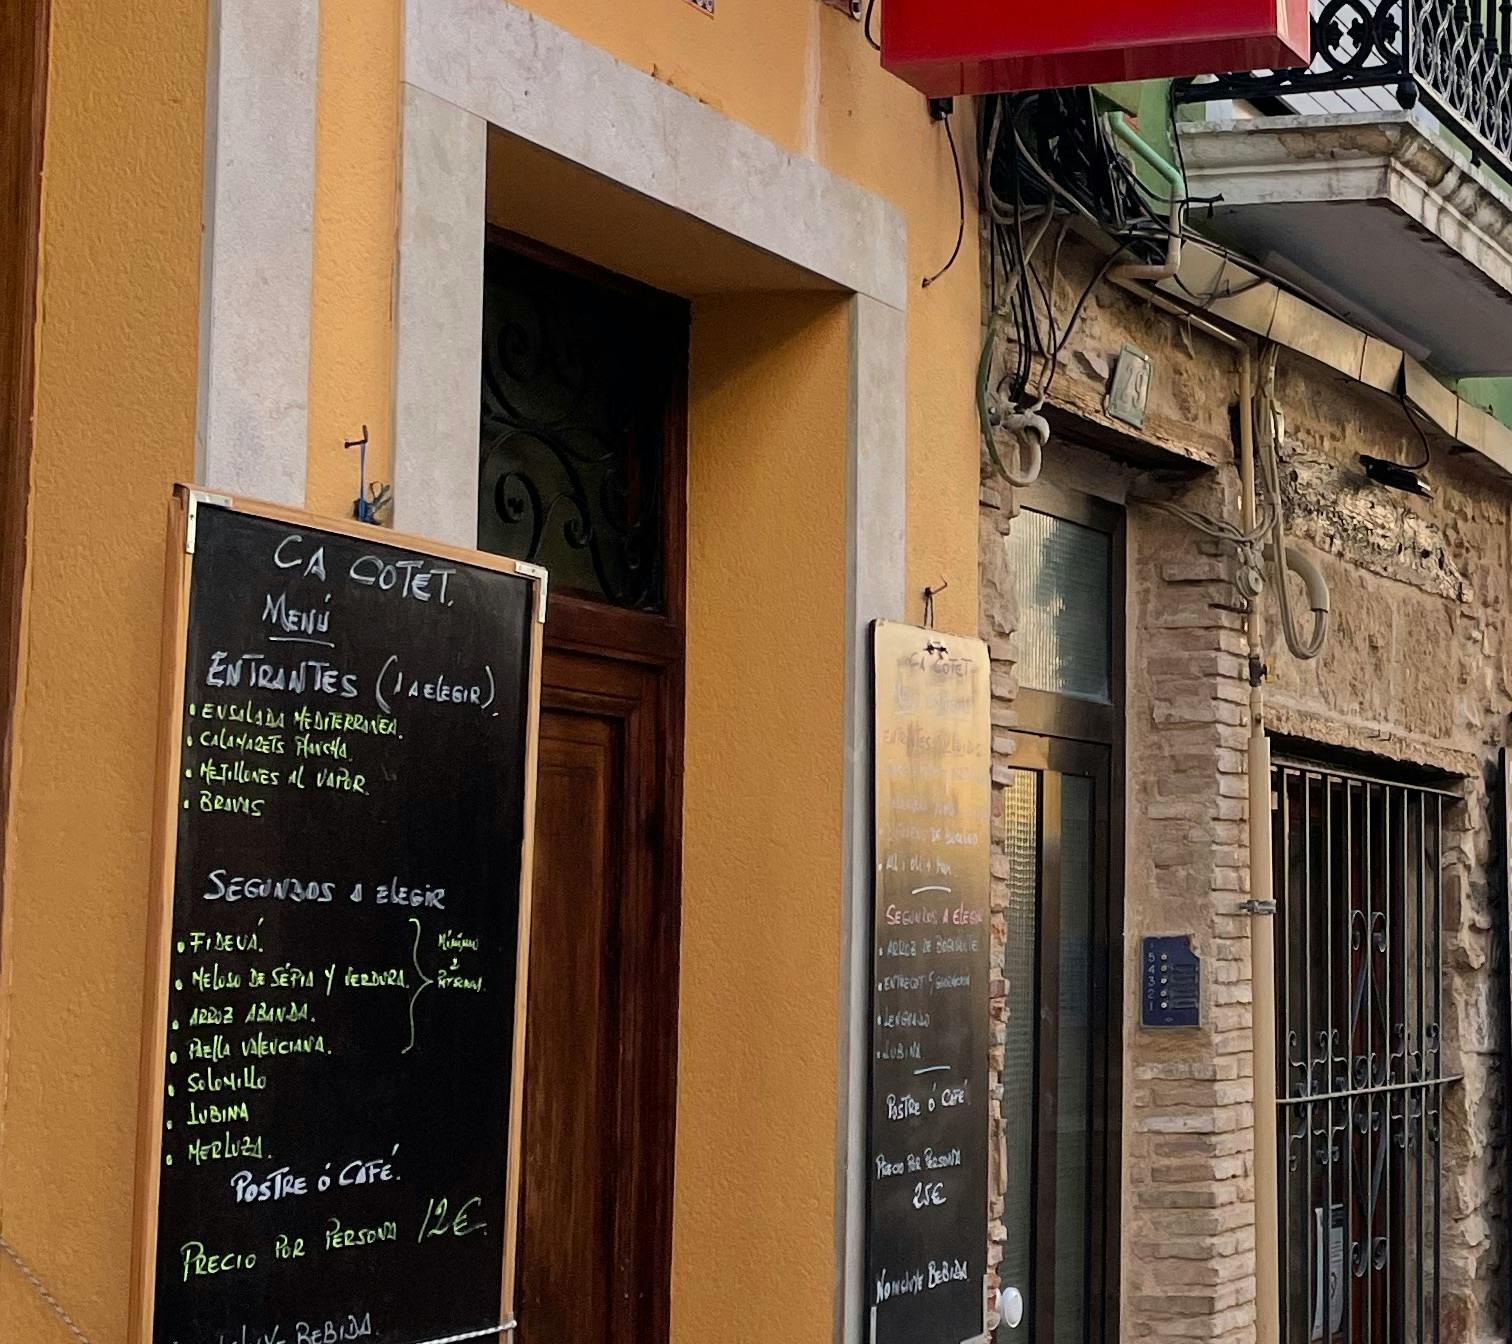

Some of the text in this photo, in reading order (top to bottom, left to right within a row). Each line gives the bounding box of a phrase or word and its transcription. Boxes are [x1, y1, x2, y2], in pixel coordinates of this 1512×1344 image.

[274, 535, 327, 582] CA
[206, 651, 358, 698] ENTRANTES
[200, 728, 285, 754] CALAMARETS
[200, 791, 265, 816] BRAVAS
[203, 868, 335, 904] SEGUNDOS
[376, 880, 446, 910] ELEGIR
[885, 903, 938, 927] SEGUNDOS
[887, 938, 916, 959] ARROZ
[922, 937, 932, 954] DE
[192, 963, 241, 991] MELOSO
[249, 969, 265, 988] DE
[325, 964, 335, 996] Y
[189, 1006, 234, 1026] ARROZ
[189, 1034, 231, 1062] PAELLA
[882, 1040, 921, 1059] LUBINA
[187, 1065, 267, 1092] SOLOMILLO
[187, 1102, 249, 1126] LUBINA
[886, 1093, 921, 1120] POSTRE
[875, 1147, 961, 1180] PRECIO POR PERSONA
[230, 1167, 308, 1203] POSTRE
[181, 1242, 256, 1282] PRECIO
[275, 1233, 305, 1260] POR
[325, 1217, 398, 1251] PERSONA
[928, 1258, 968, 1289] BEBIDA
